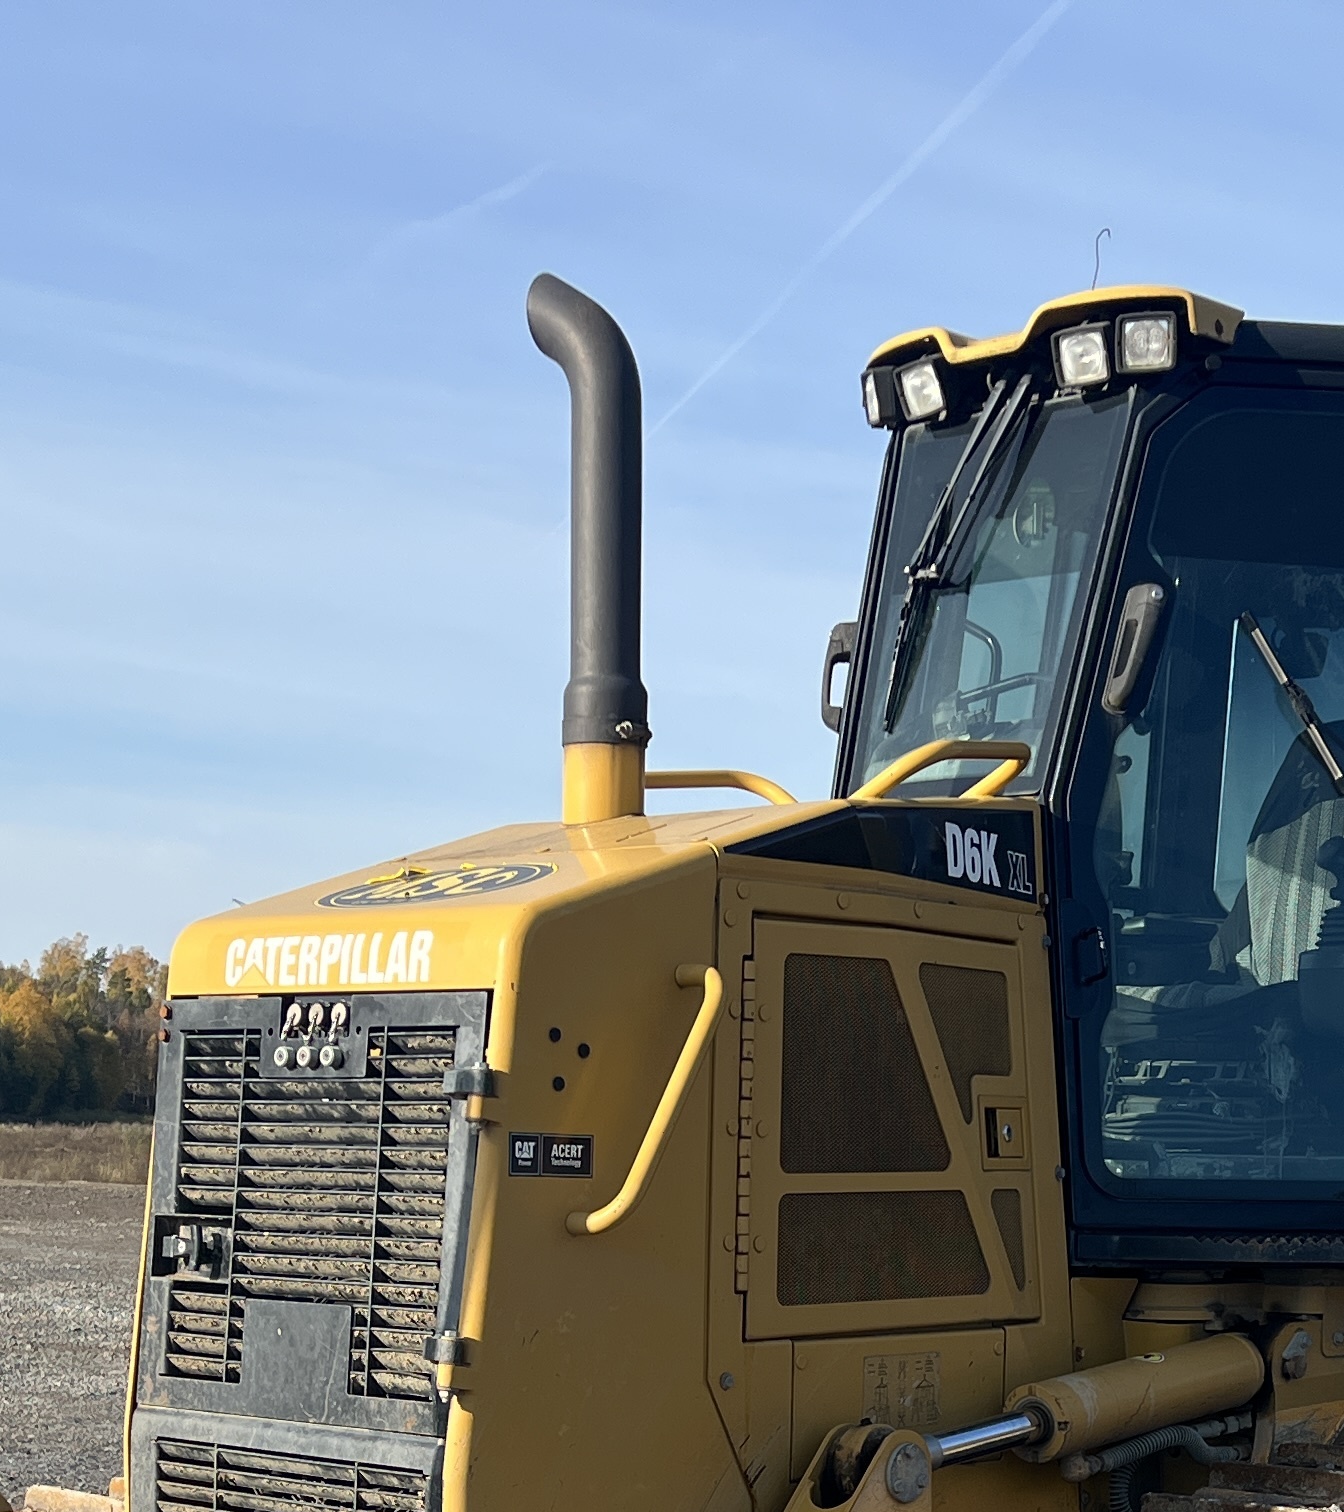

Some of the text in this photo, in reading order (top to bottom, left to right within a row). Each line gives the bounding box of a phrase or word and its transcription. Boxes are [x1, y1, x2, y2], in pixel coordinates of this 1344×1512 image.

[945, 821, 1033, 895] D6K XL
[225, 930, 434, 988] CATERPILLAR
[515, 1141, 536, 1159] CAT
[551, 1143, 584, 1158] ACERT
[550, 1157, 582, 1169] Technology
